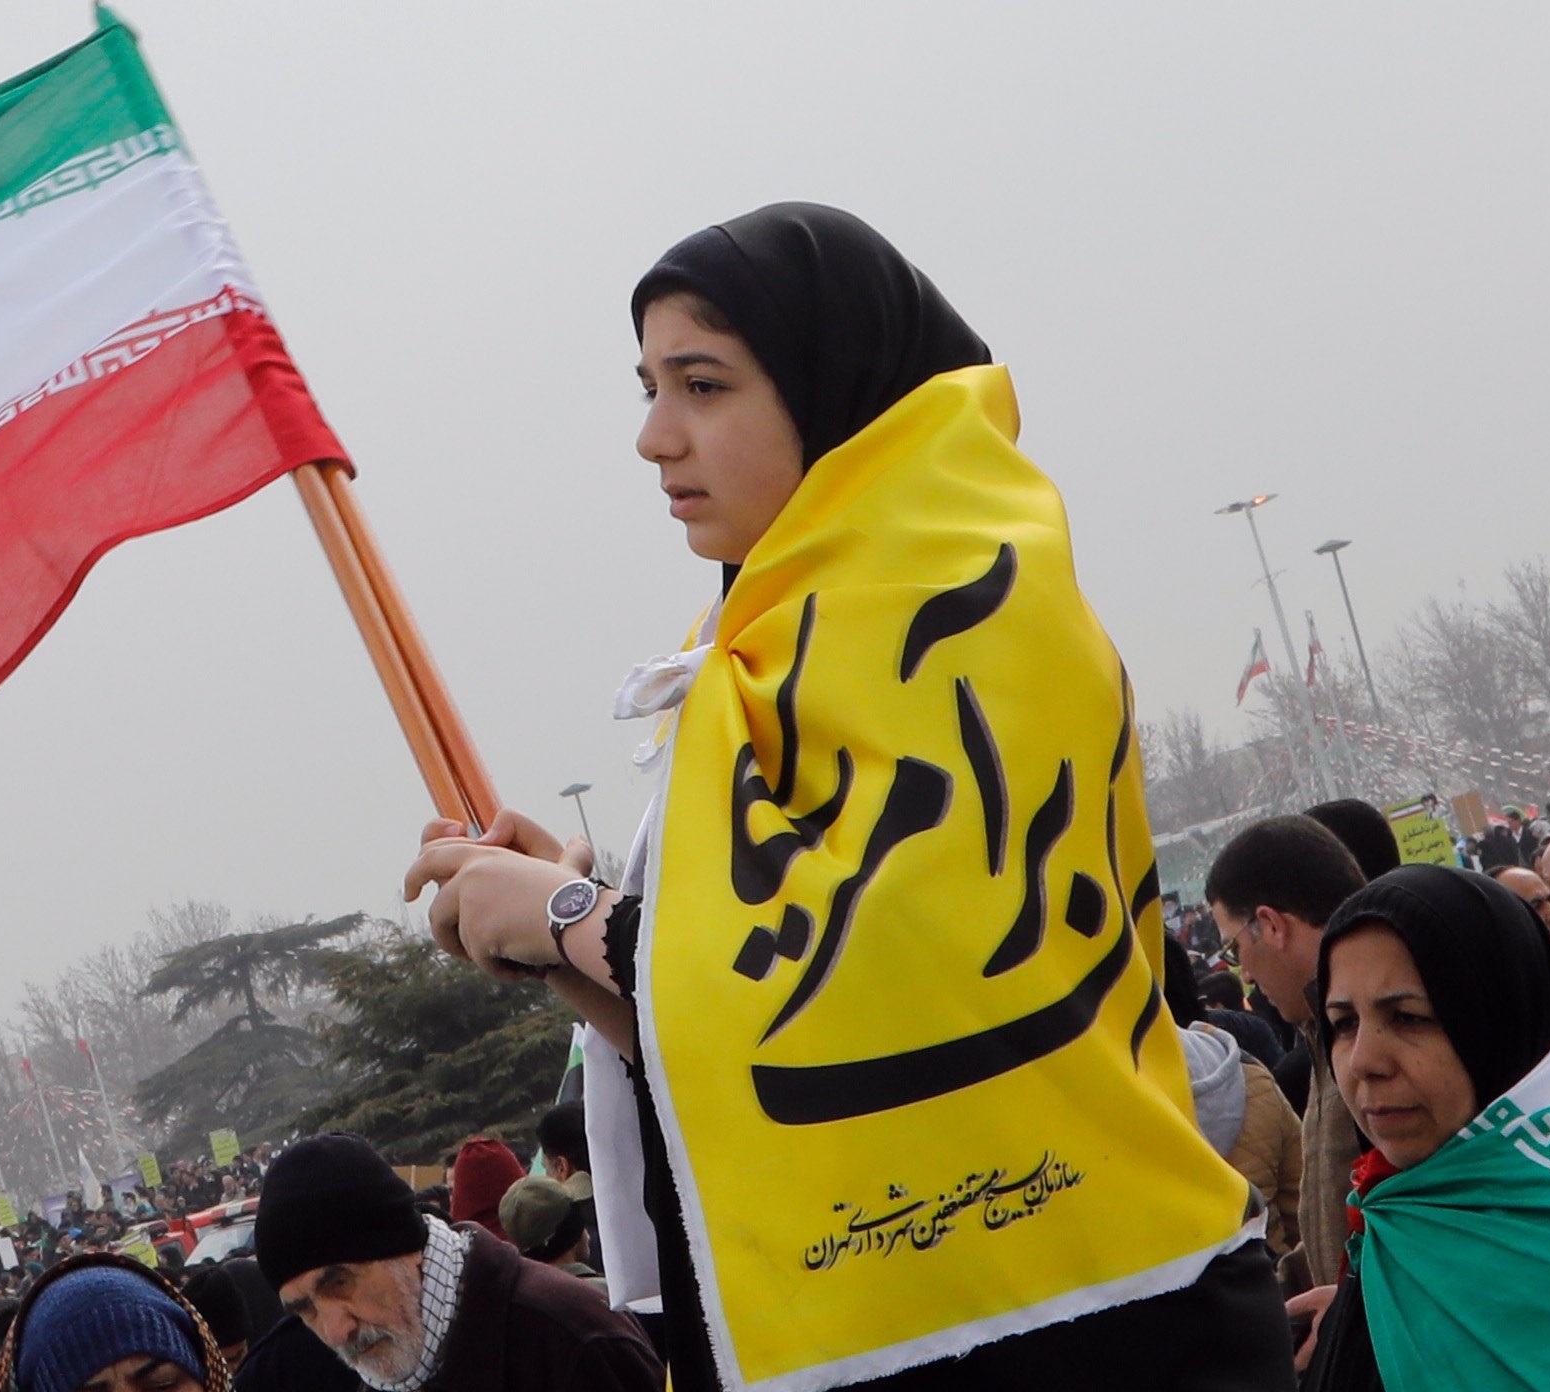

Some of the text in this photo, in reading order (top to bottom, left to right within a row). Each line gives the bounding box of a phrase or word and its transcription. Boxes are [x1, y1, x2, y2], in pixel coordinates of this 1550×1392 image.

[804, 1150, 1082, 1271] سازمان بسیج مستضعفین شهرداری تهران
